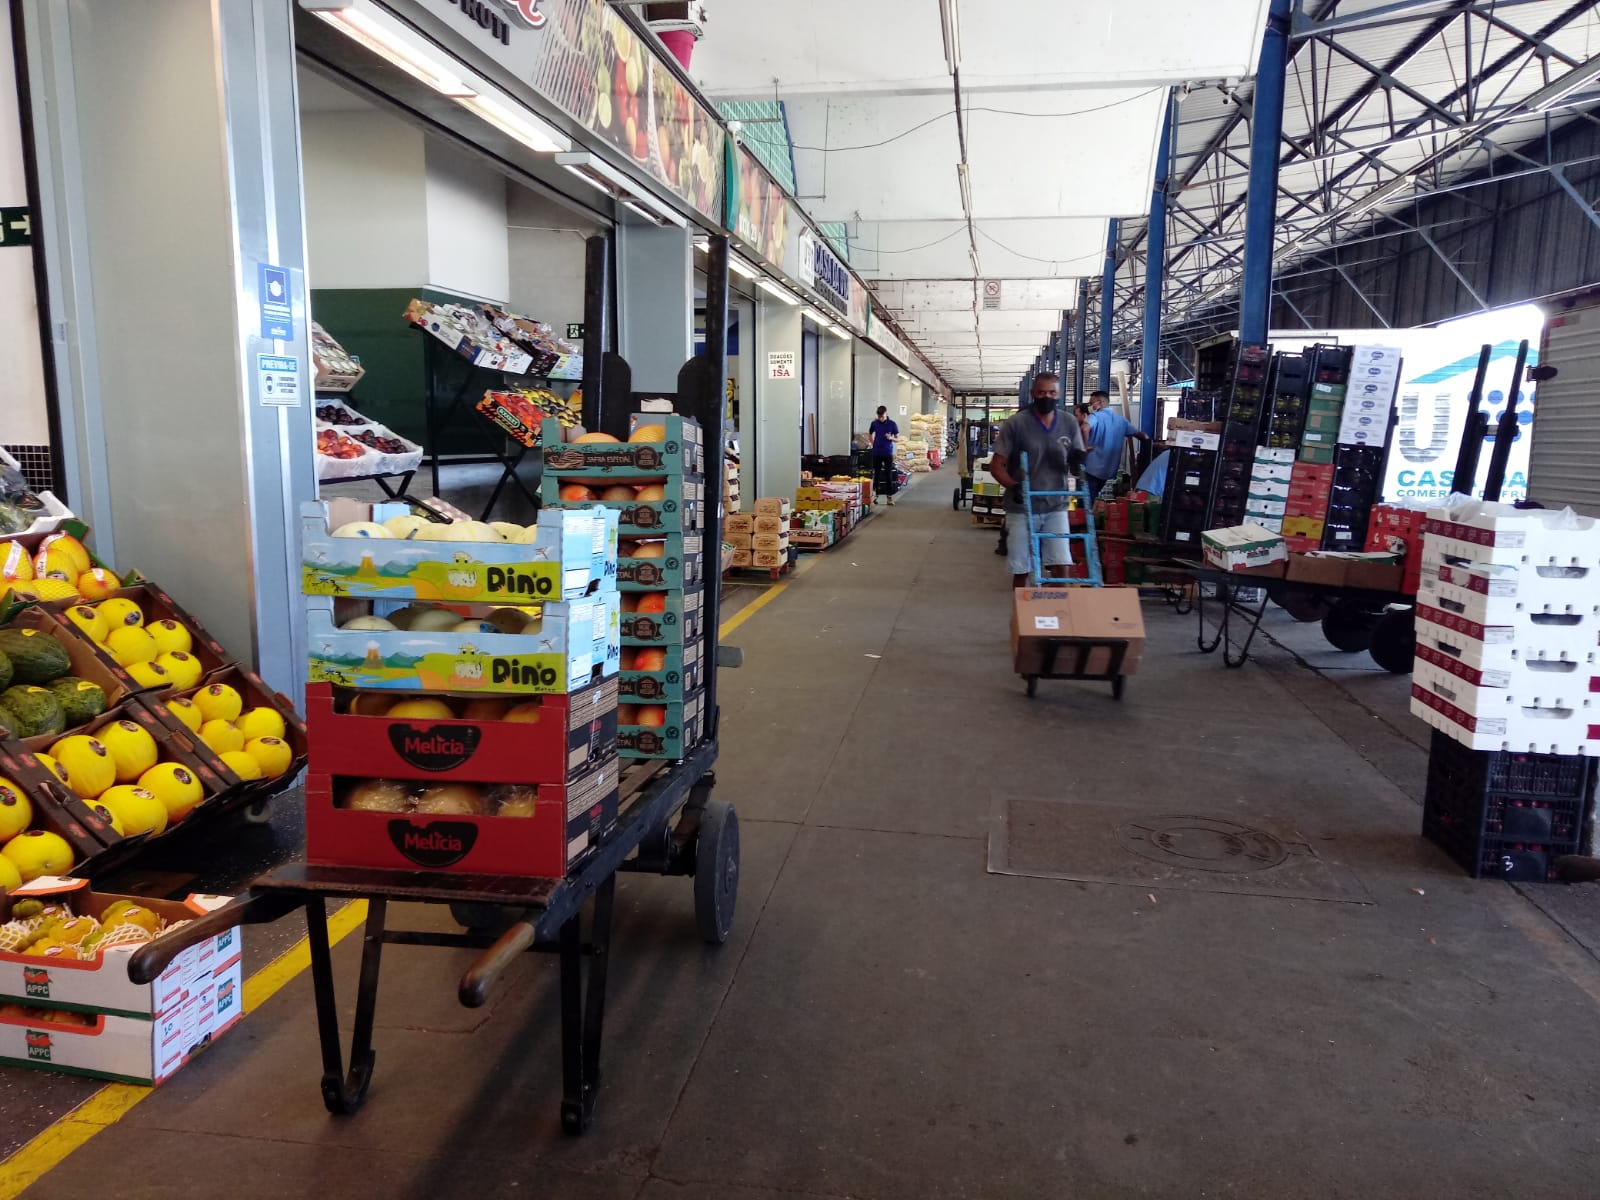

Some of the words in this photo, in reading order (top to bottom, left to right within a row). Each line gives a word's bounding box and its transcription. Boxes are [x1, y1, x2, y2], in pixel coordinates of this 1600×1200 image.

[773, 369, 790, 377] ISA
[1397, 470, 1477, 488] CAS
[487, 566, 553, 595] Dino
[607, 644, 619, 660] Dino
[493, 658, 557, 686] Dino
[26, 984, 49, 994] APPC
[29, 1047, 50, 1057] APPC
